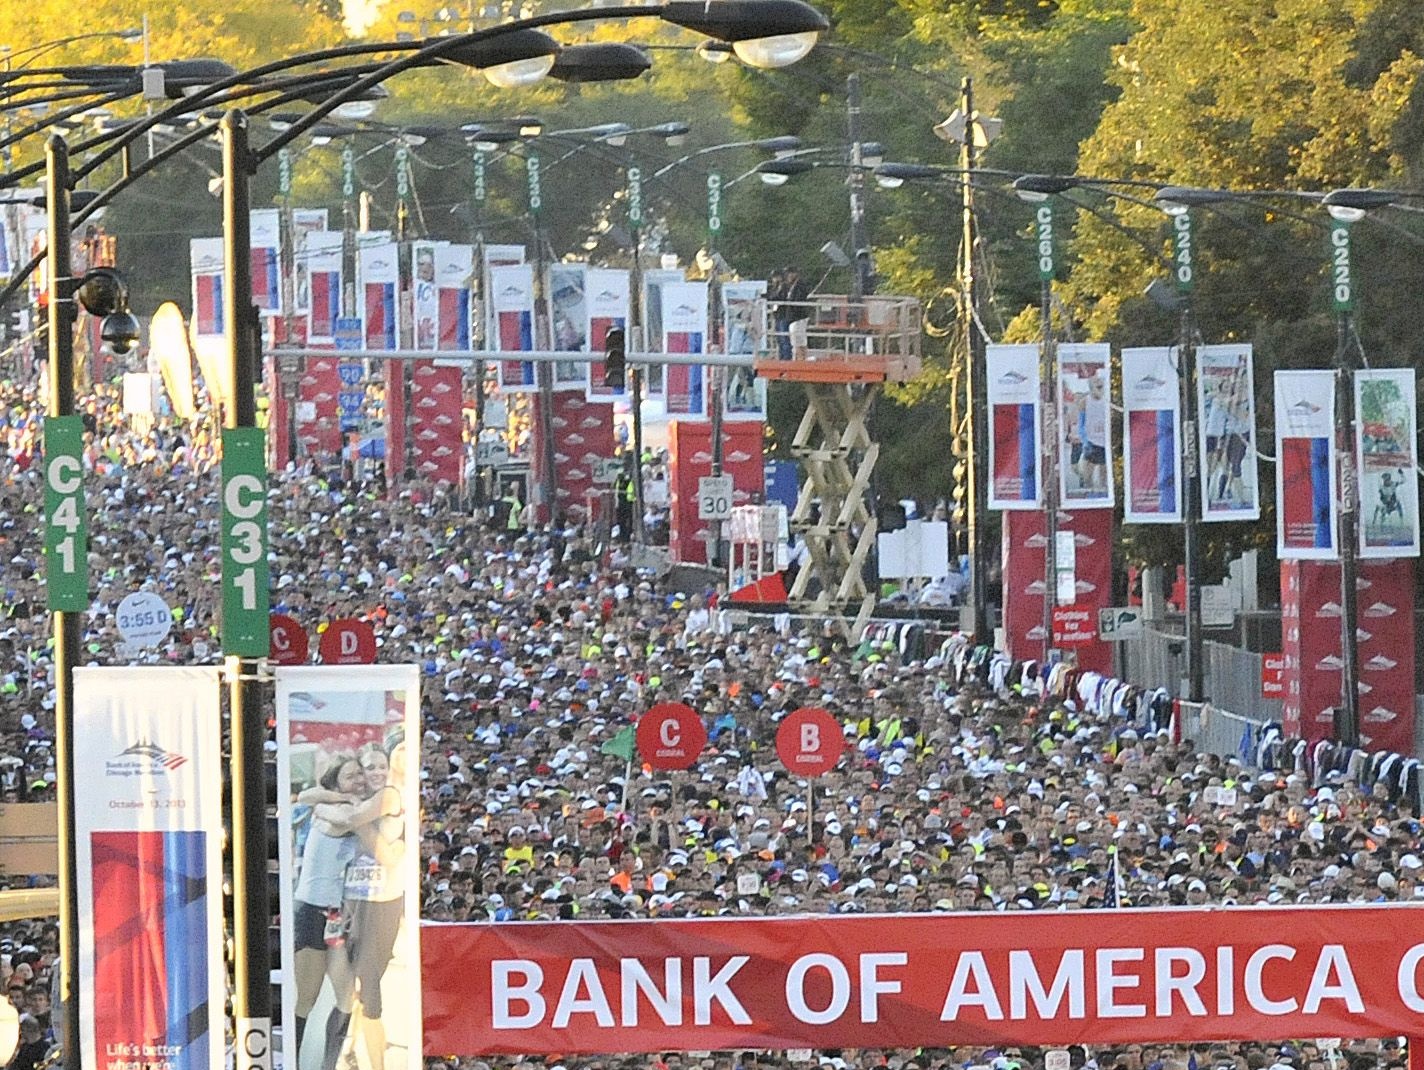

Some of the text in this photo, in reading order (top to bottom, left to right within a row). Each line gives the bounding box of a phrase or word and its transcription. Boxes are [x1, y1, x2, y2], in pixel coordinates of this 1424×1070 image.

[628, 167, 641, 221] C320
[707, 174, 721, 230] C310
[1037, 207, 1053, 272] C260
[1175, 214, 1192, 283] C240
[1331, 228, 1350, 302] C220
[48, 455, 81, 573] C41
[703, 497, 728, 514] 30
[225, 474, 264, 610] C31
[120, 608, 168, 629] 3:55 D
[272, 627, 290, 651] C
[341, 631, 359, 655] D
[660, 719, 681, 748] C
[801, 723, 821, 753] B
[491, 955, 752, 1029] BANK
[785, 952, 908, 1025] OF
[940, 944, 1366, 1021] AMERICA
[106, 1043, 141, 1057] Life's
